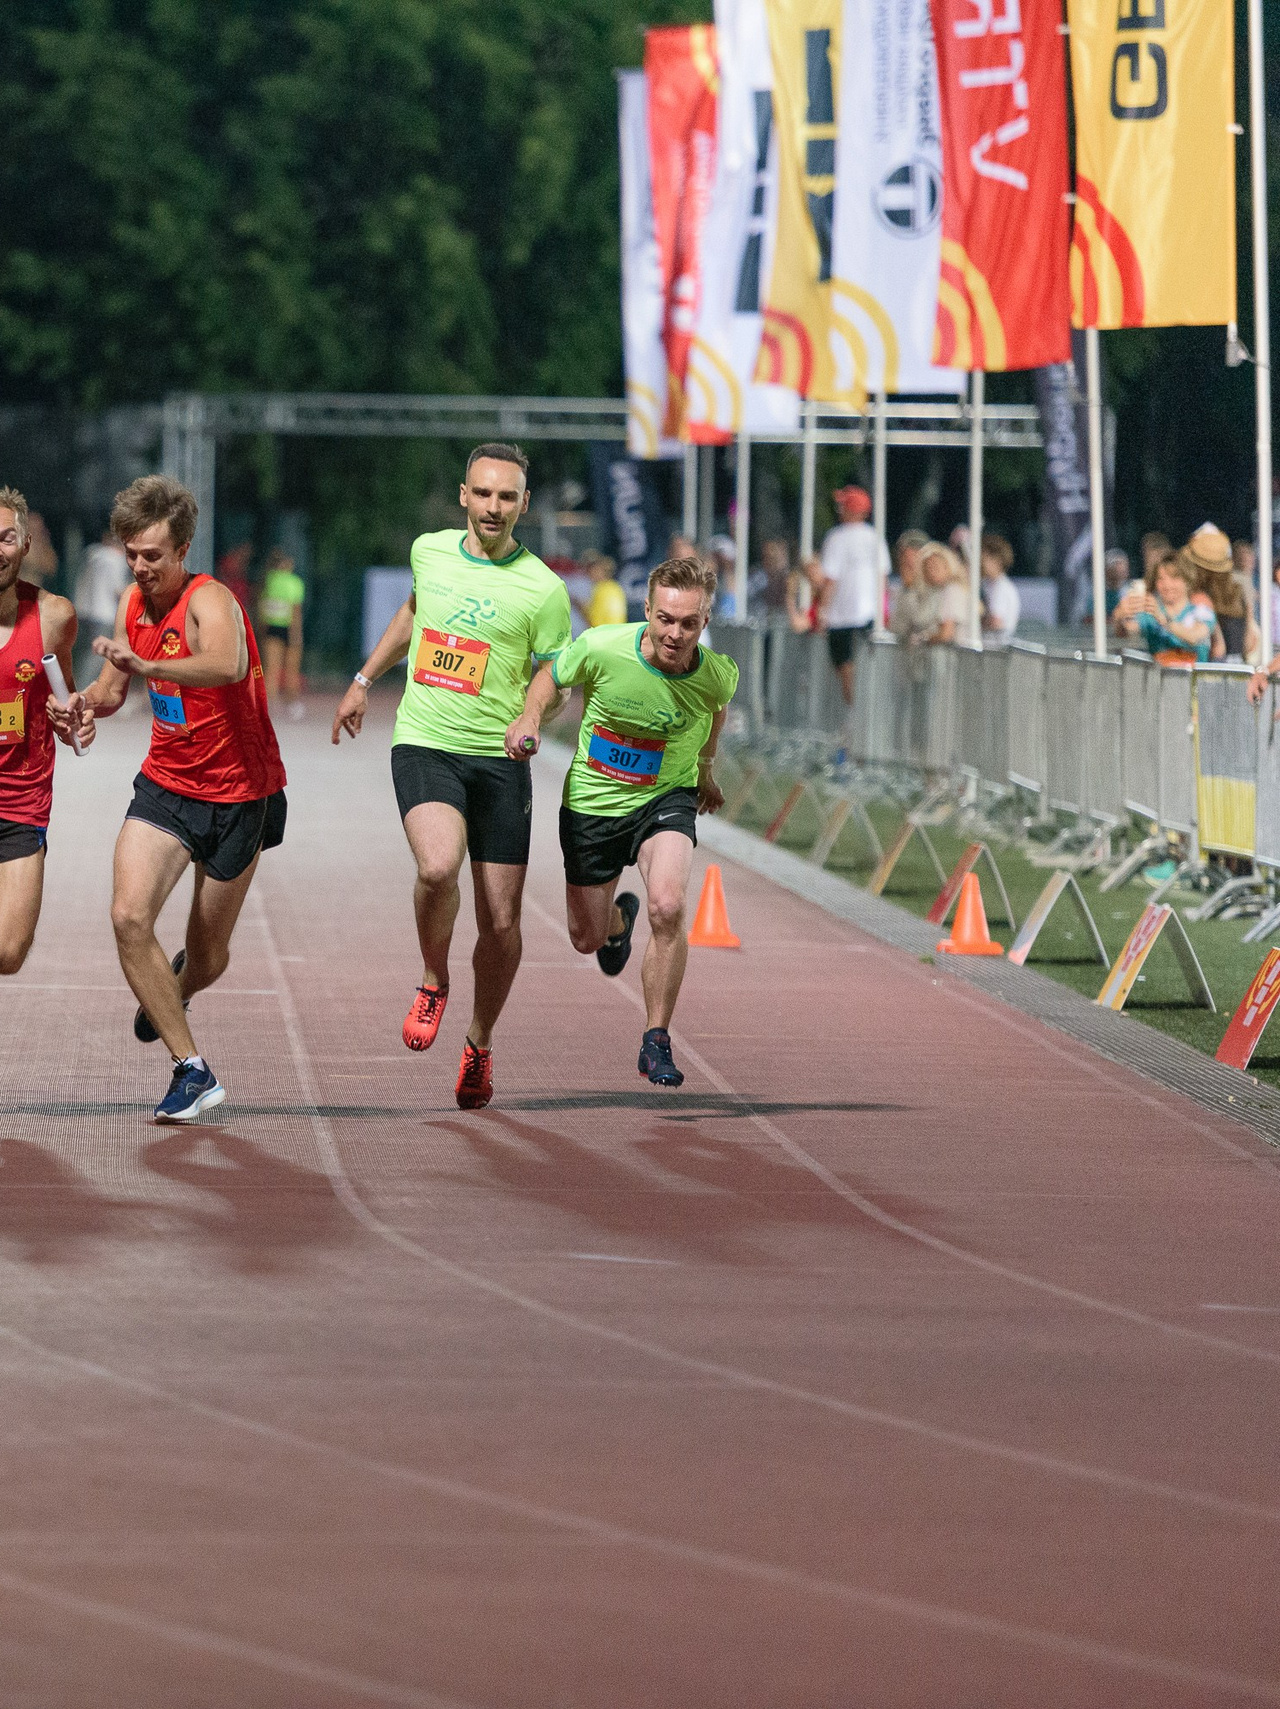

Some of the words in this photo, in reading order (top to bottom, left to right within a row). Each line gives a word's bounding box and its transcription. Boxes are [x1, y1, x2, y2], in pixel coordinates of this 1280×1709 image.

[432, 650, 465, 672] 307
[469, 666, 476, 676] 2
[9, 716, 16, 726] 2
[173, 709, 179, 719] 3
[608, 748, 642, 768] 307
[646, 762, 654, 771] 3
